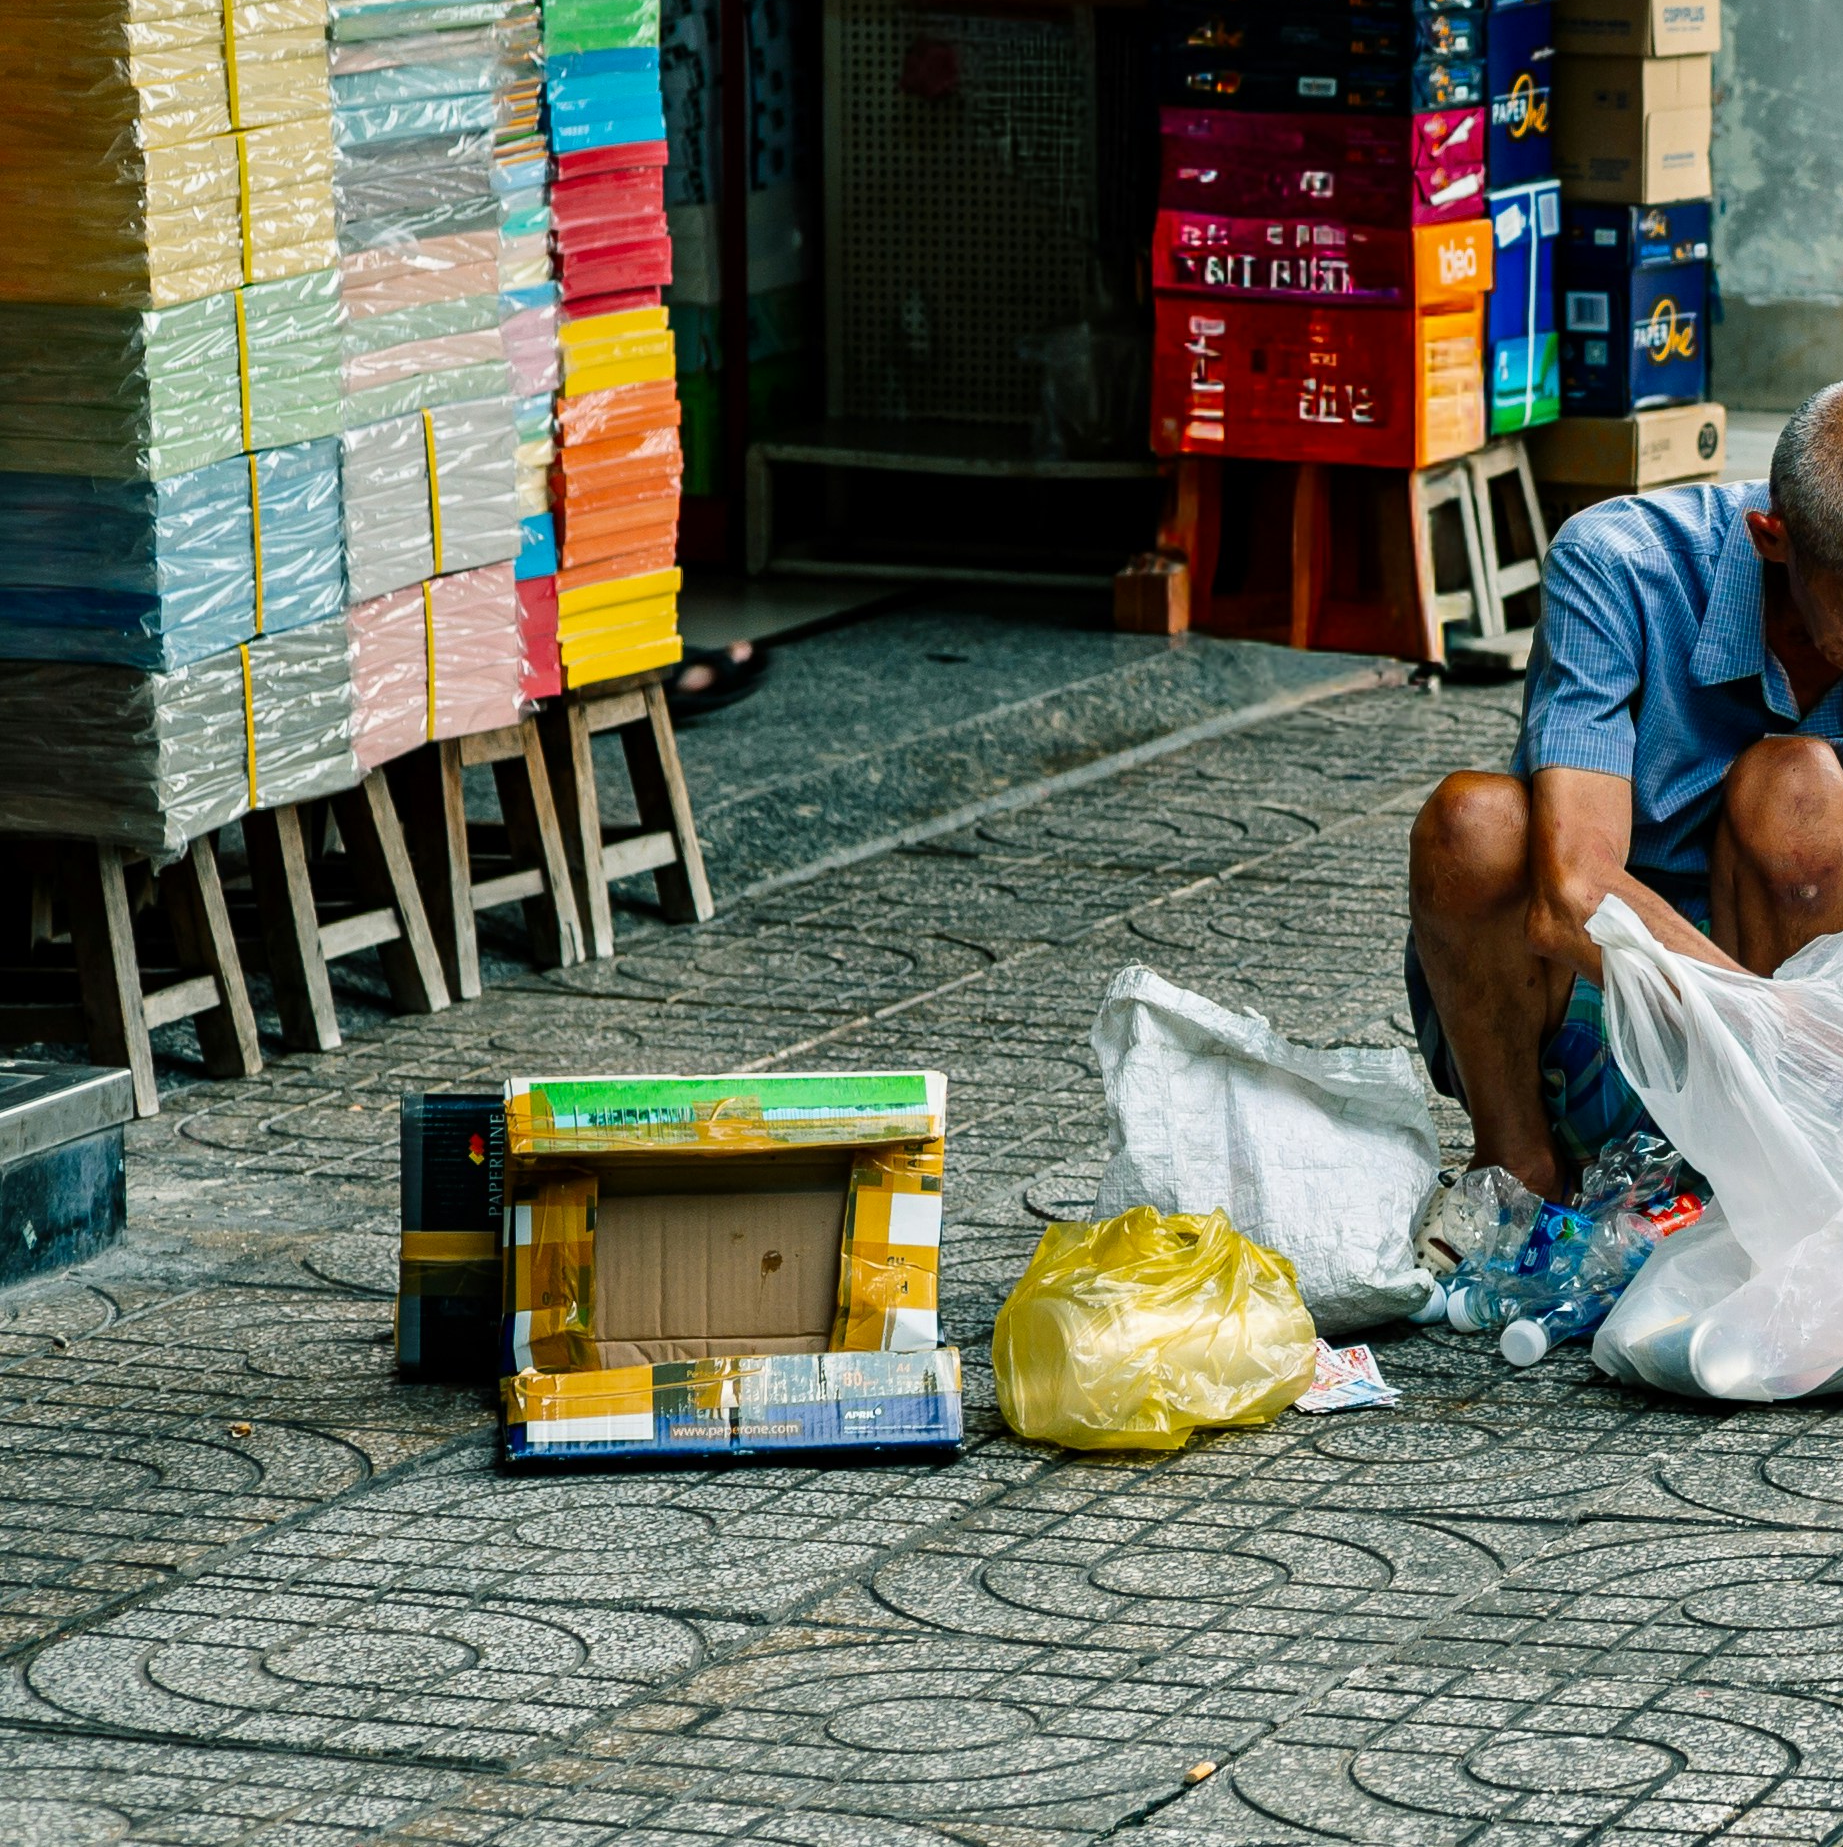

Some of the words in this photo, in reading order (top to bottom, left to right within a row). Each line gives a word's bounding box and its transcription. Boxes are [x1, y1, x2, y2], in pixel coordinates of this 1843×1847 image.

[1492, 97, 1527, 126] PAPER
[1633, 321, 1668, 351] PAPER
[487, 1112, 505, 1219] PAPERLINE
[842, 1370, 863, 1387] 80
[843, 1407, 877, 1420] APRIL
[671, 1421, 800, 1440] www.paperone.com
